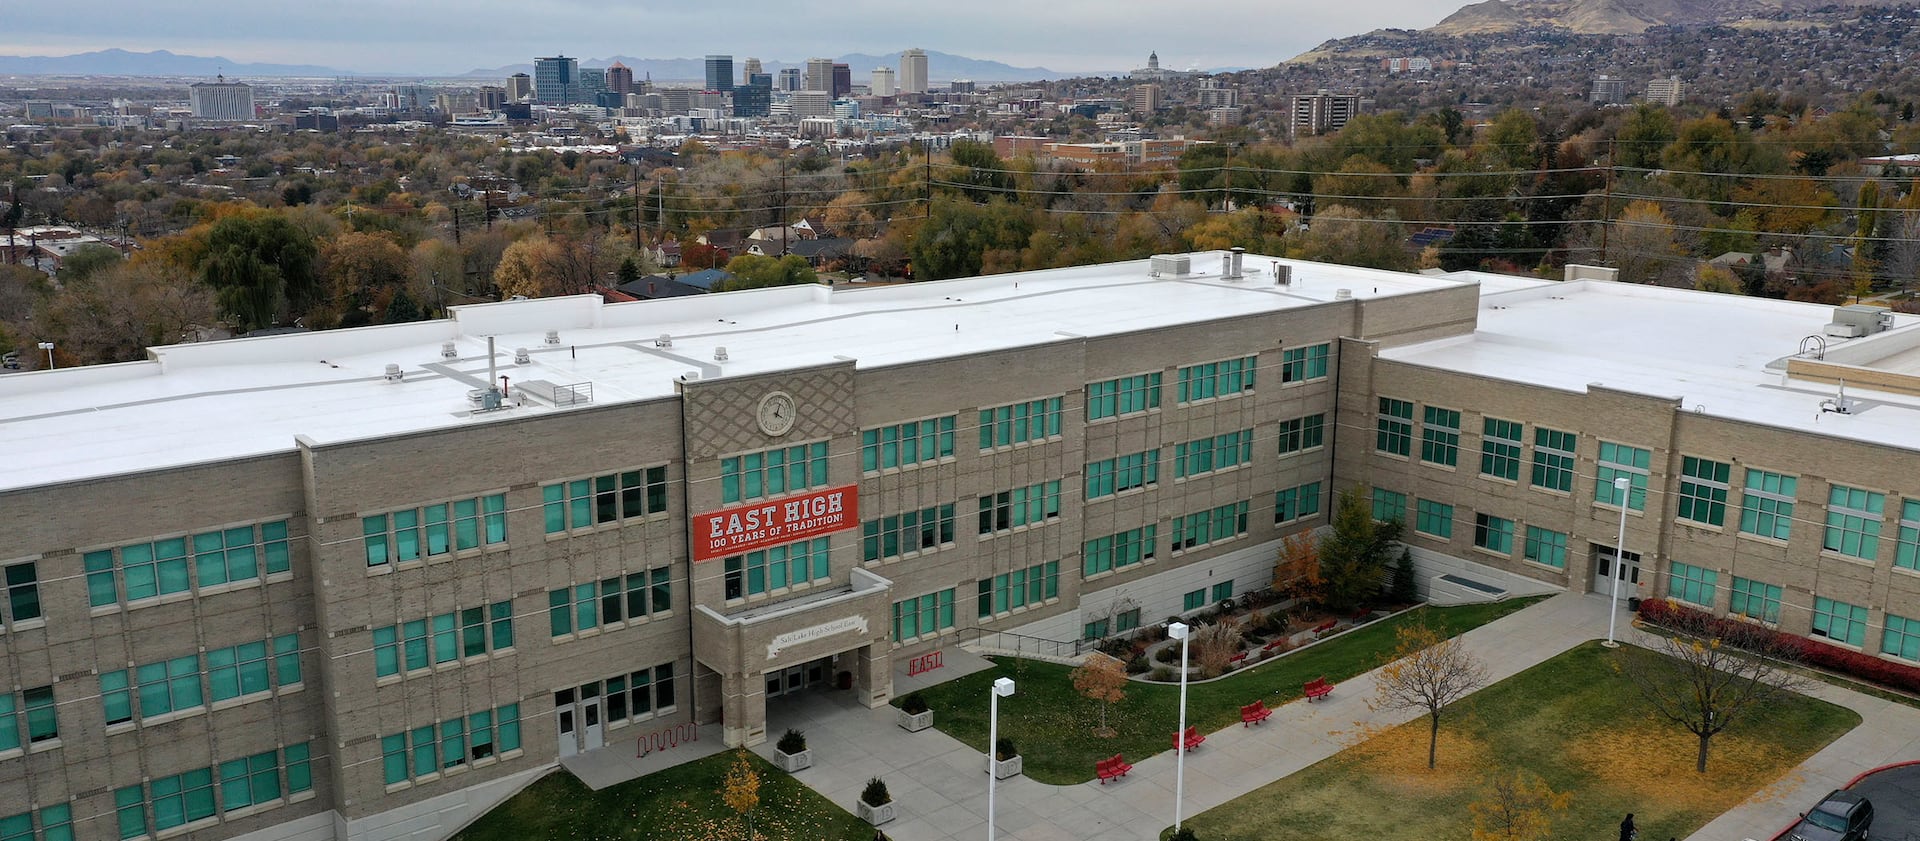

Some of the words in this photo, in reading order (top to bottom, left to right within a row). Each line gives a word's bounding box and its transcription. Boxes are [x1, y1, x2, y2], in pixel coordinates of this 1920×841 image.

[709, 506, 777, 538] EAST
[784, 492, 844, 523] HIGH
[710, 538, 727, 549] 100
[731, 530, 766, 545] YEARS
[769, 526, 782, 536] OF
[786, 513, 843, 533] TRADITION!
[808, 628, 824, 637] High
[824, 623, 843, 633] School
[911, 650, 942, 674] EAST
